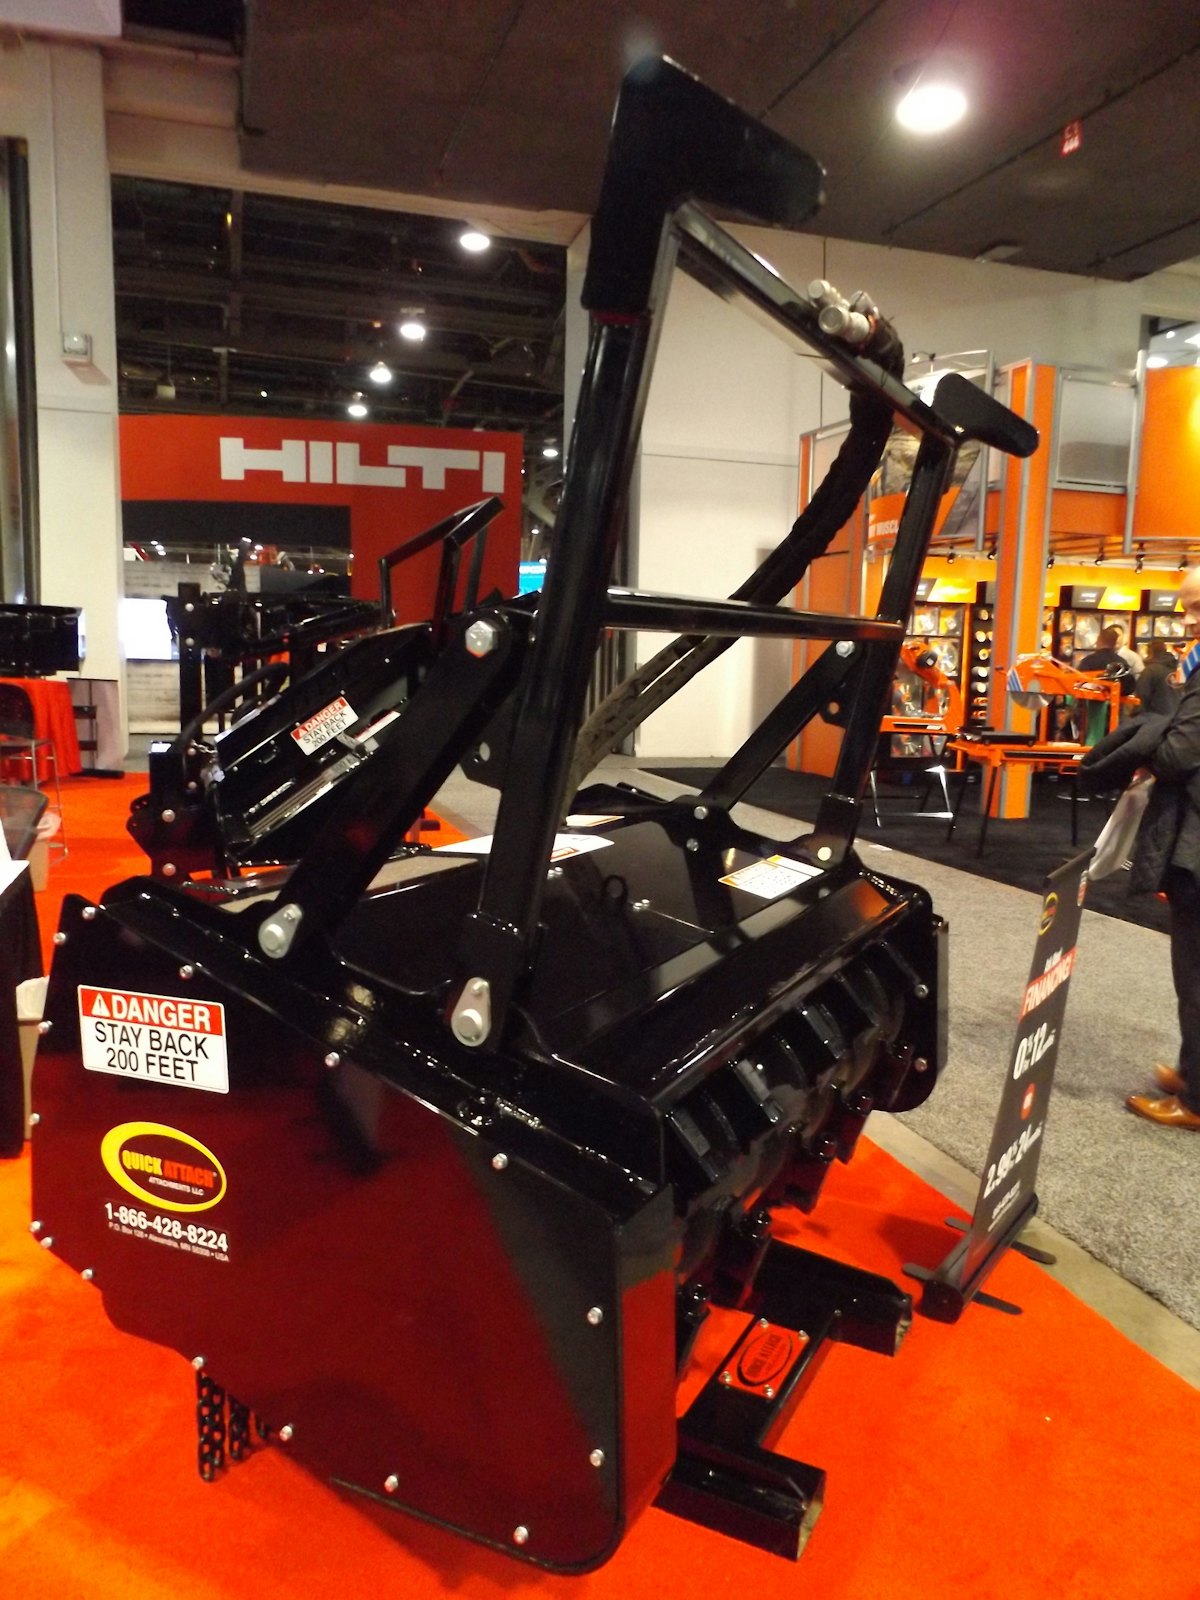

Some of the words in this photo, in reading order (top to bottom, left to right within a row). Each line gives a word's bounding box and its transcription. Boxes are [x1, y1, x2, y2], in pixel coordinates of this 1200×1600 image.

[220, 437, 505, 493] HILTI
[303, 726, 324, 744] STAY
[325, 711, 347, 730] BACK
[305, 701, 343, 731] DANGER
[311, 734, 327, 748] 200
[327, 720, 347, 736] FEET
[111, 995, 211, 1031] DANGER
[95, 1021, 142, 1048] STAY
[149, 1030, 209, 1059] BACK
[106, 1048, 139, 1072] 200
[145, 1054, 199, 1082] FEET
[122, 1150, 162, 1176] QUICK
[163, 1160, 214, 1188] ATTACH
[191, 1187, 205, 1196] LLC
[105, 1202, 228, 1252] 1-866-428-8224
